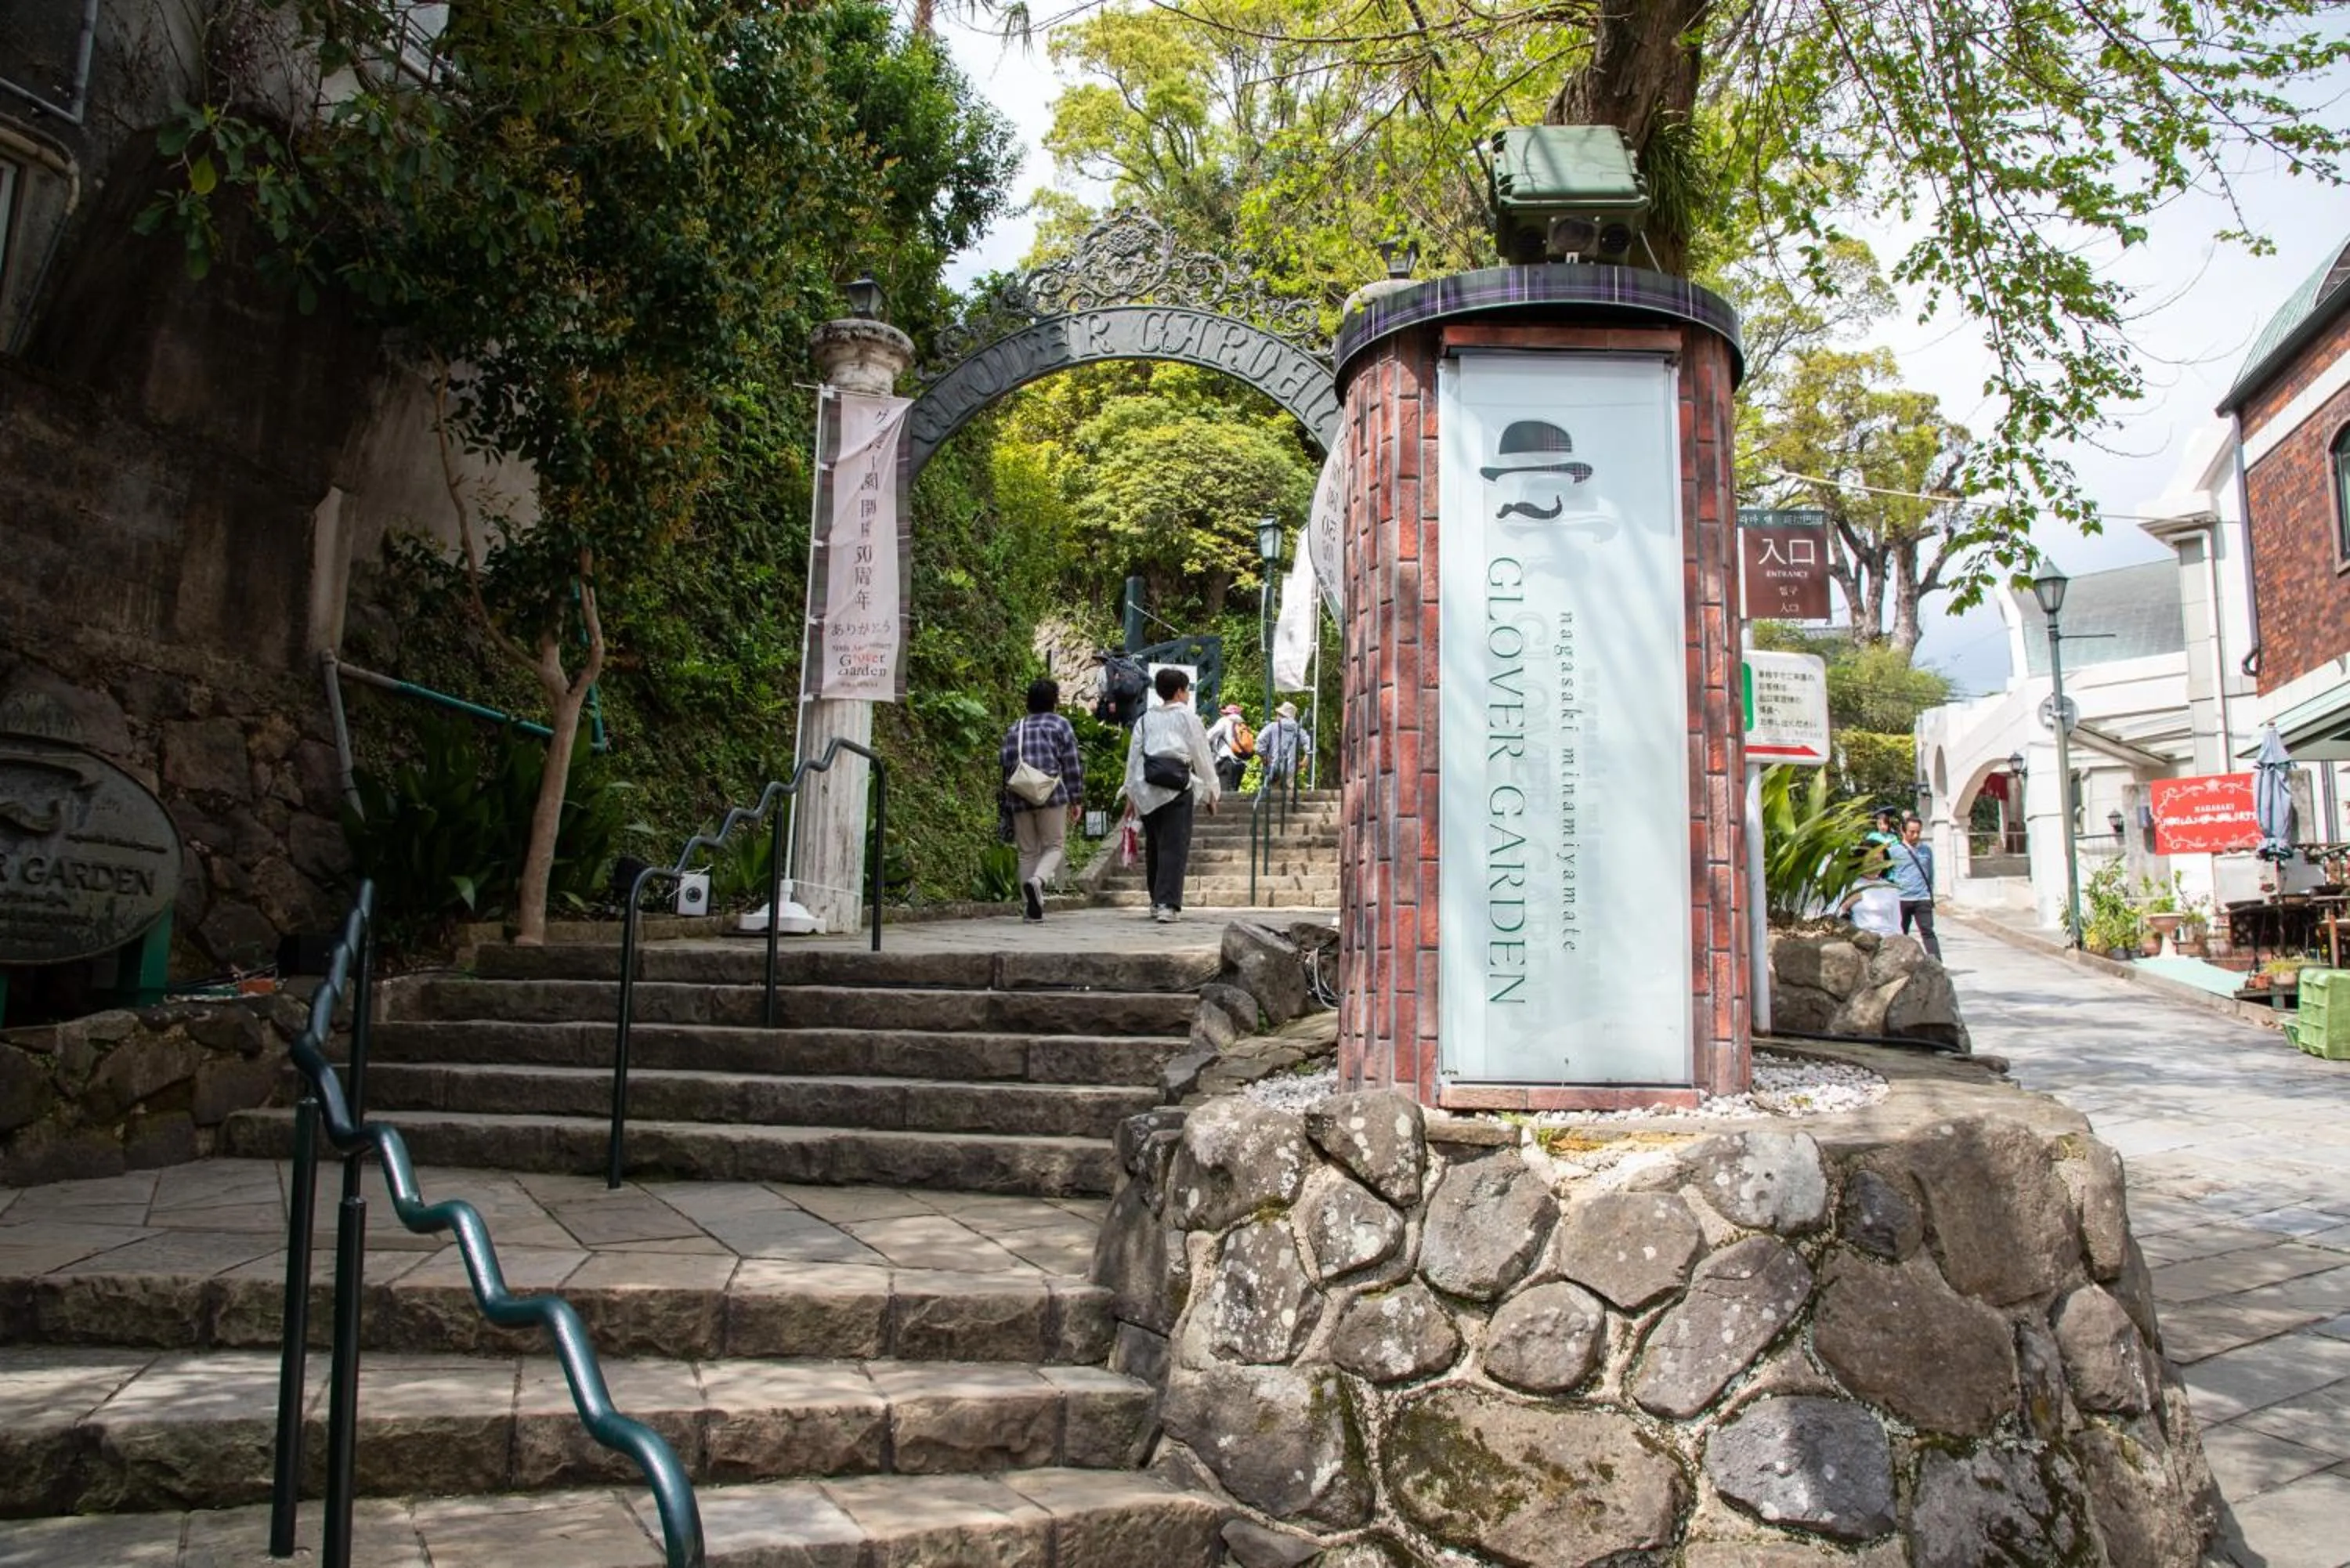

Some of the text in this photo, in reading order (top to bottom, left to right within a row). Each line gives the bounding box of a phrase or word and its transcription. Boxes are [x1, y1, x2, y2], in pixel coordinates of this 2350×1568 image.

[1757, 538, 1816, 565] 入口
[1766, 569, 1809, 578] ENTRANCE
[831, 620, 891, 637] ありがとう
[1488, 556, 1527, 1004] GLOVER GARDEN
[1553, 611, 1583, 952] nagasaki minamiyamate
[21, 855, 155, 898] GARDEN
